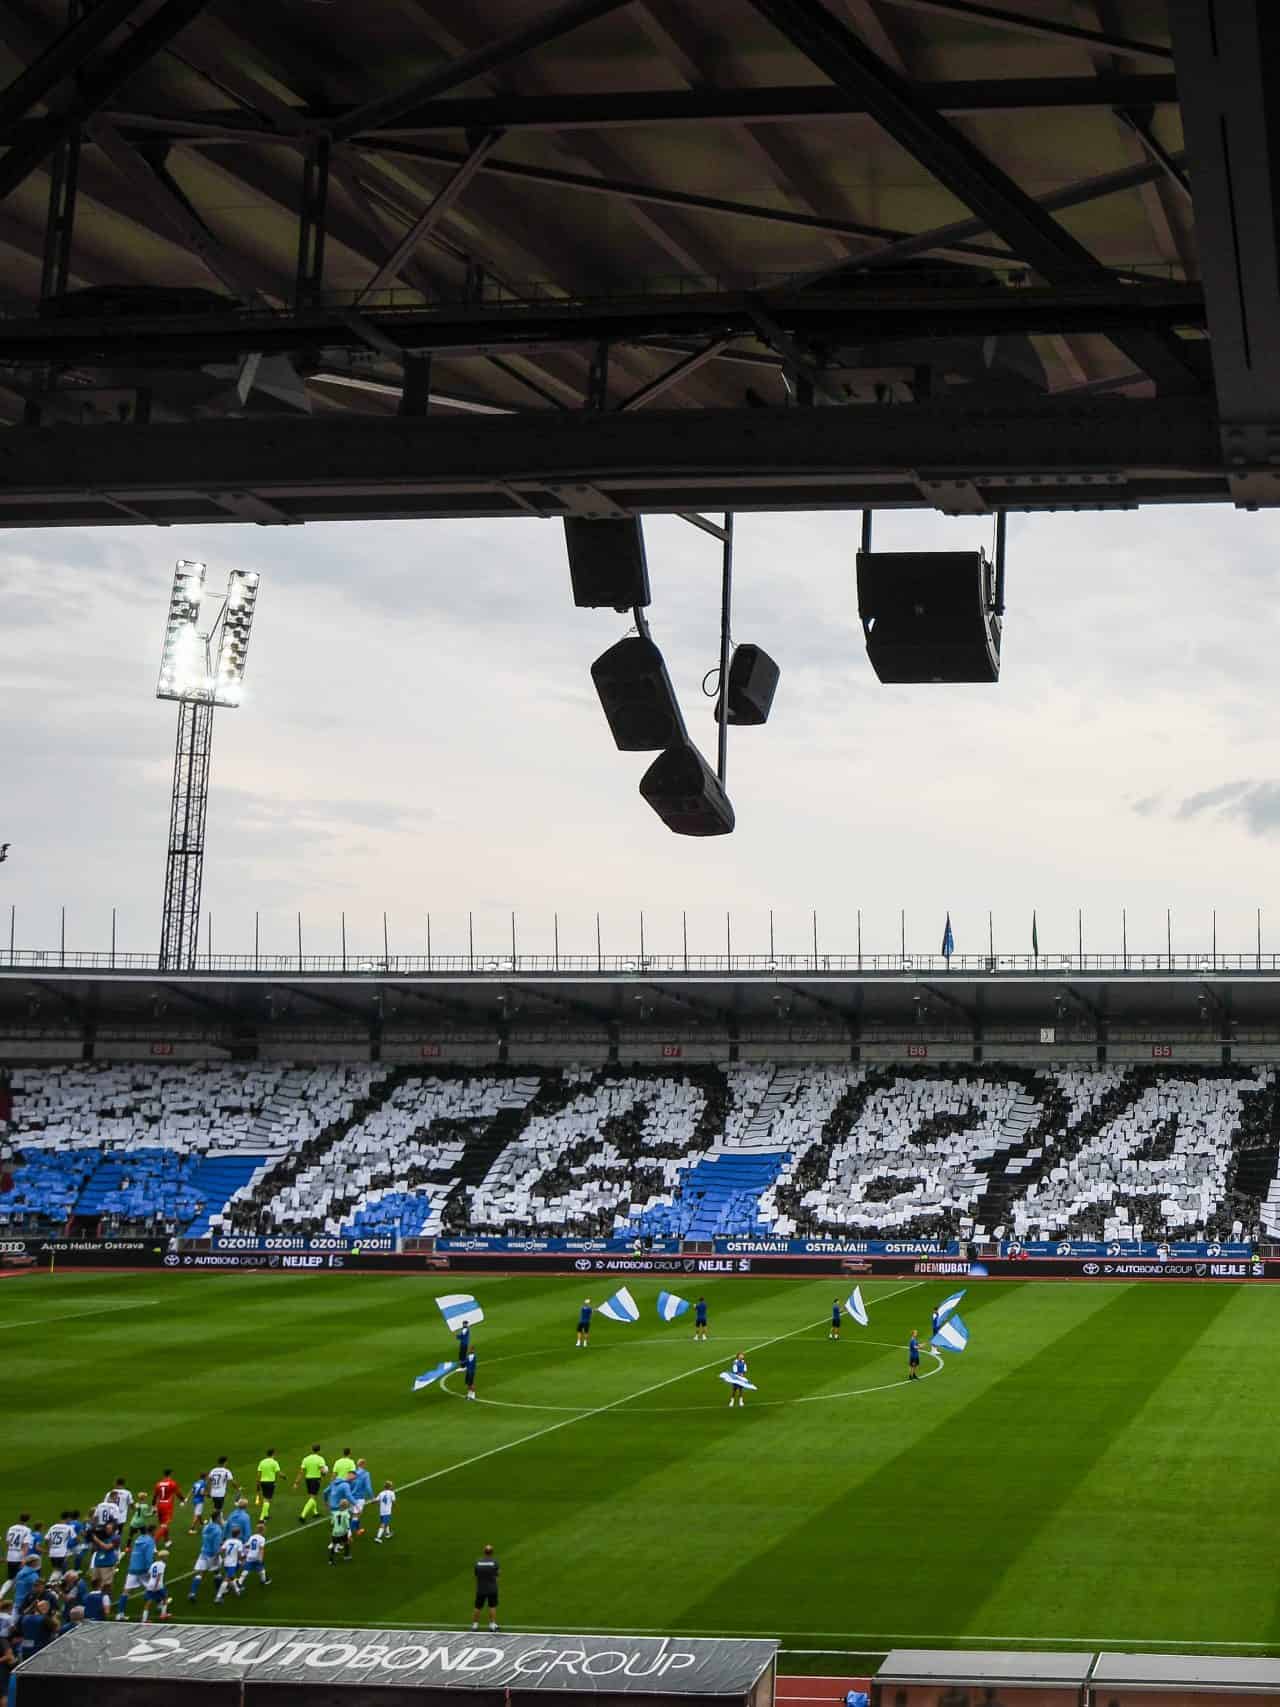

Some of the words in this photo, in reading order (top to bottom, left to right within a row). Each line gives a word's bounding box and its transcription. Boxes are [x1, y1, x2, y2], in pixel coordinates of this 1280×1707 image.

[40, 1242, 68, 1250] Auto
[70, 1241, 102, 1250] Heller
[104, 1242, 145, 1250] Ostrava
[218, 1238, 259, 1248] OZO!!!
[265, 1238, 304, 1248] OZO!!!
[310, 1239, 347, 1249] OZO!!!
[353, 1239, 391, 1249] OZO!!!
[727, 1242, 788, 1252] OSTRAVA!!!
[806, 1243, 868, 1252] OSTRAVA!!!
[194, 1256, 239, 1265] AUTOBOND
[240, 1256, 266, 1265] GROUP
[606, 1260, 653, 1269] AUTOBOND
[654, 1261, 681, 1270] GROUP
[1115, 1265, 1163, 1274] AUTOBOND
[1164, 1265, 1193, 1274] GROUP
[189, 1639, 503, 1672] AUTOBOND
[513, 1648, 696, 1677] GROUP
